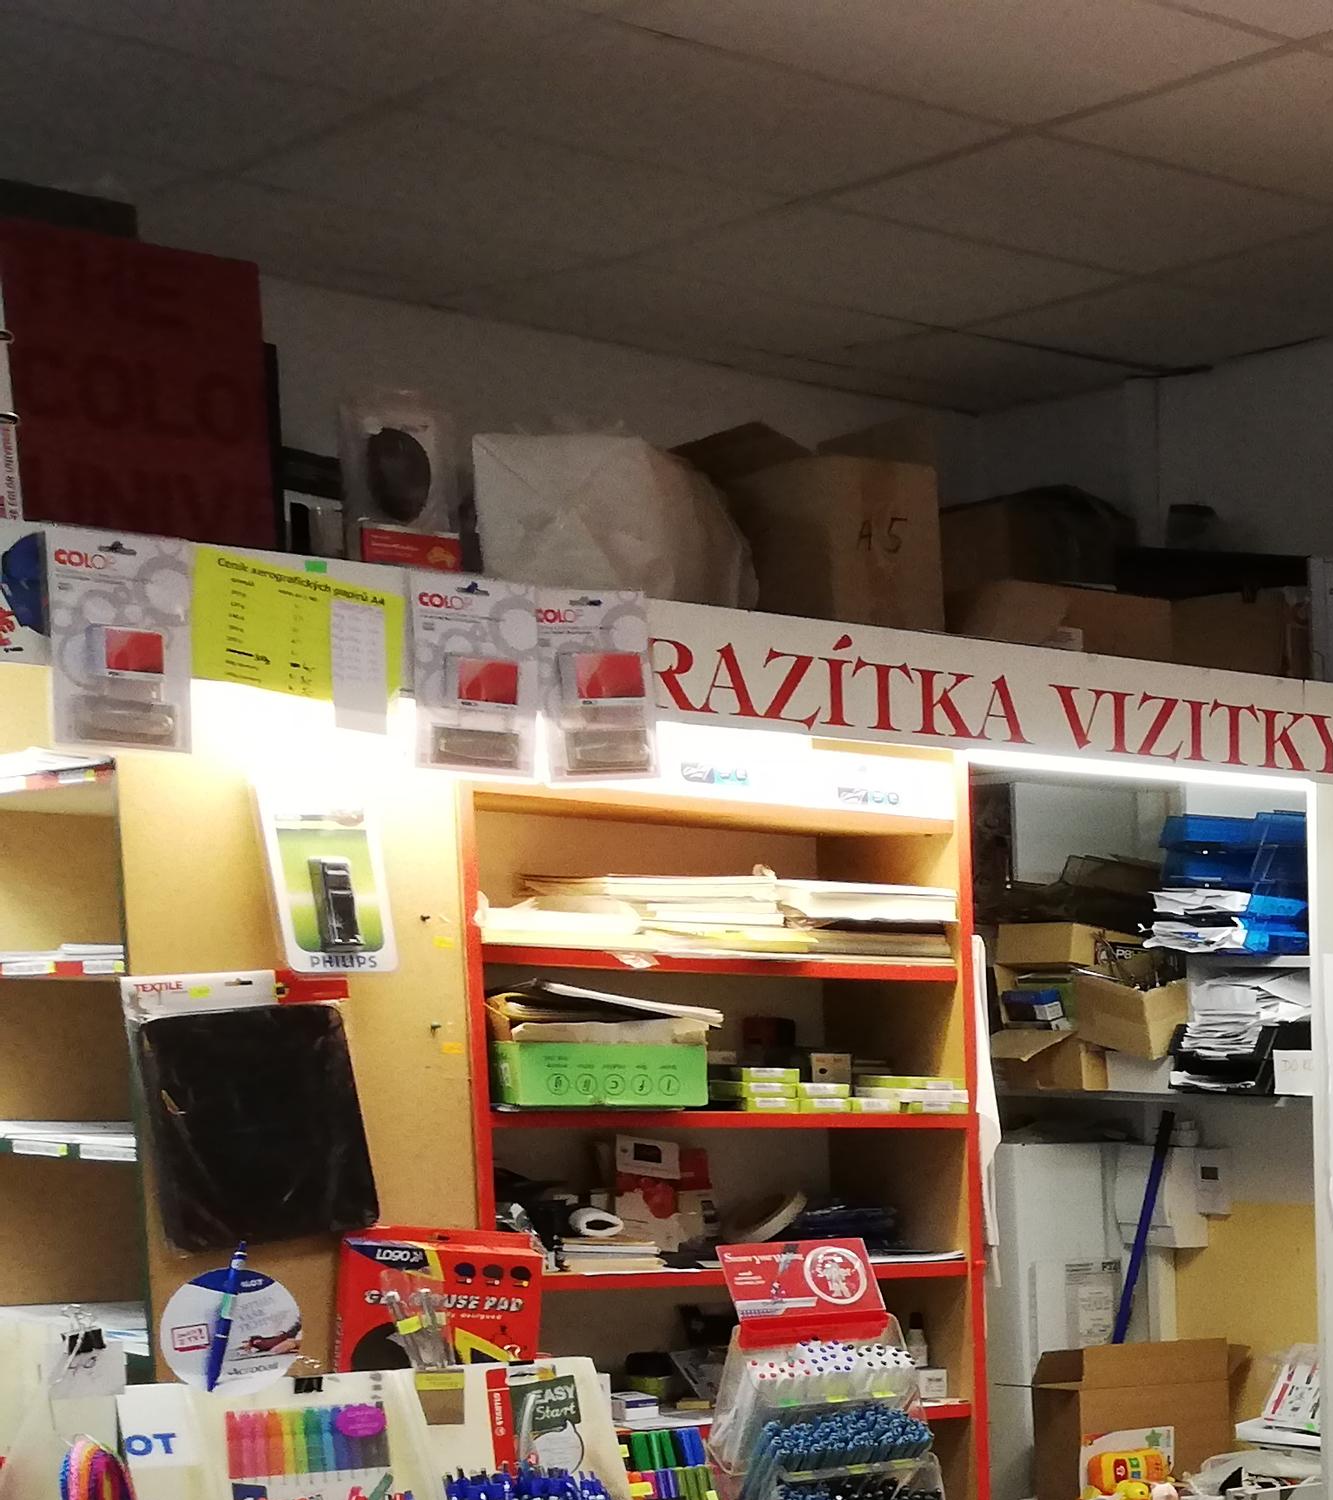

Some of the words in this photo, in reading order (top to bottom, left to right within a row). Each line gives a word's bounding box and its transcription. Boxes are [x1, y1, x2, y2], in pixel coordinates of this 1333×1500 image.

[648, 634, 1033, 745] RAZÍTKA
[308, 954, 379, 970] PHILIPS
[132, 979, 185, 994] TEXTILE
[375, 1248, 410, 1263] LOGO
[484, 1297, 525, 1313] PAD
[529, 1383, 576, 1404] EASY
[535, 1403, 577, 1422] Start
